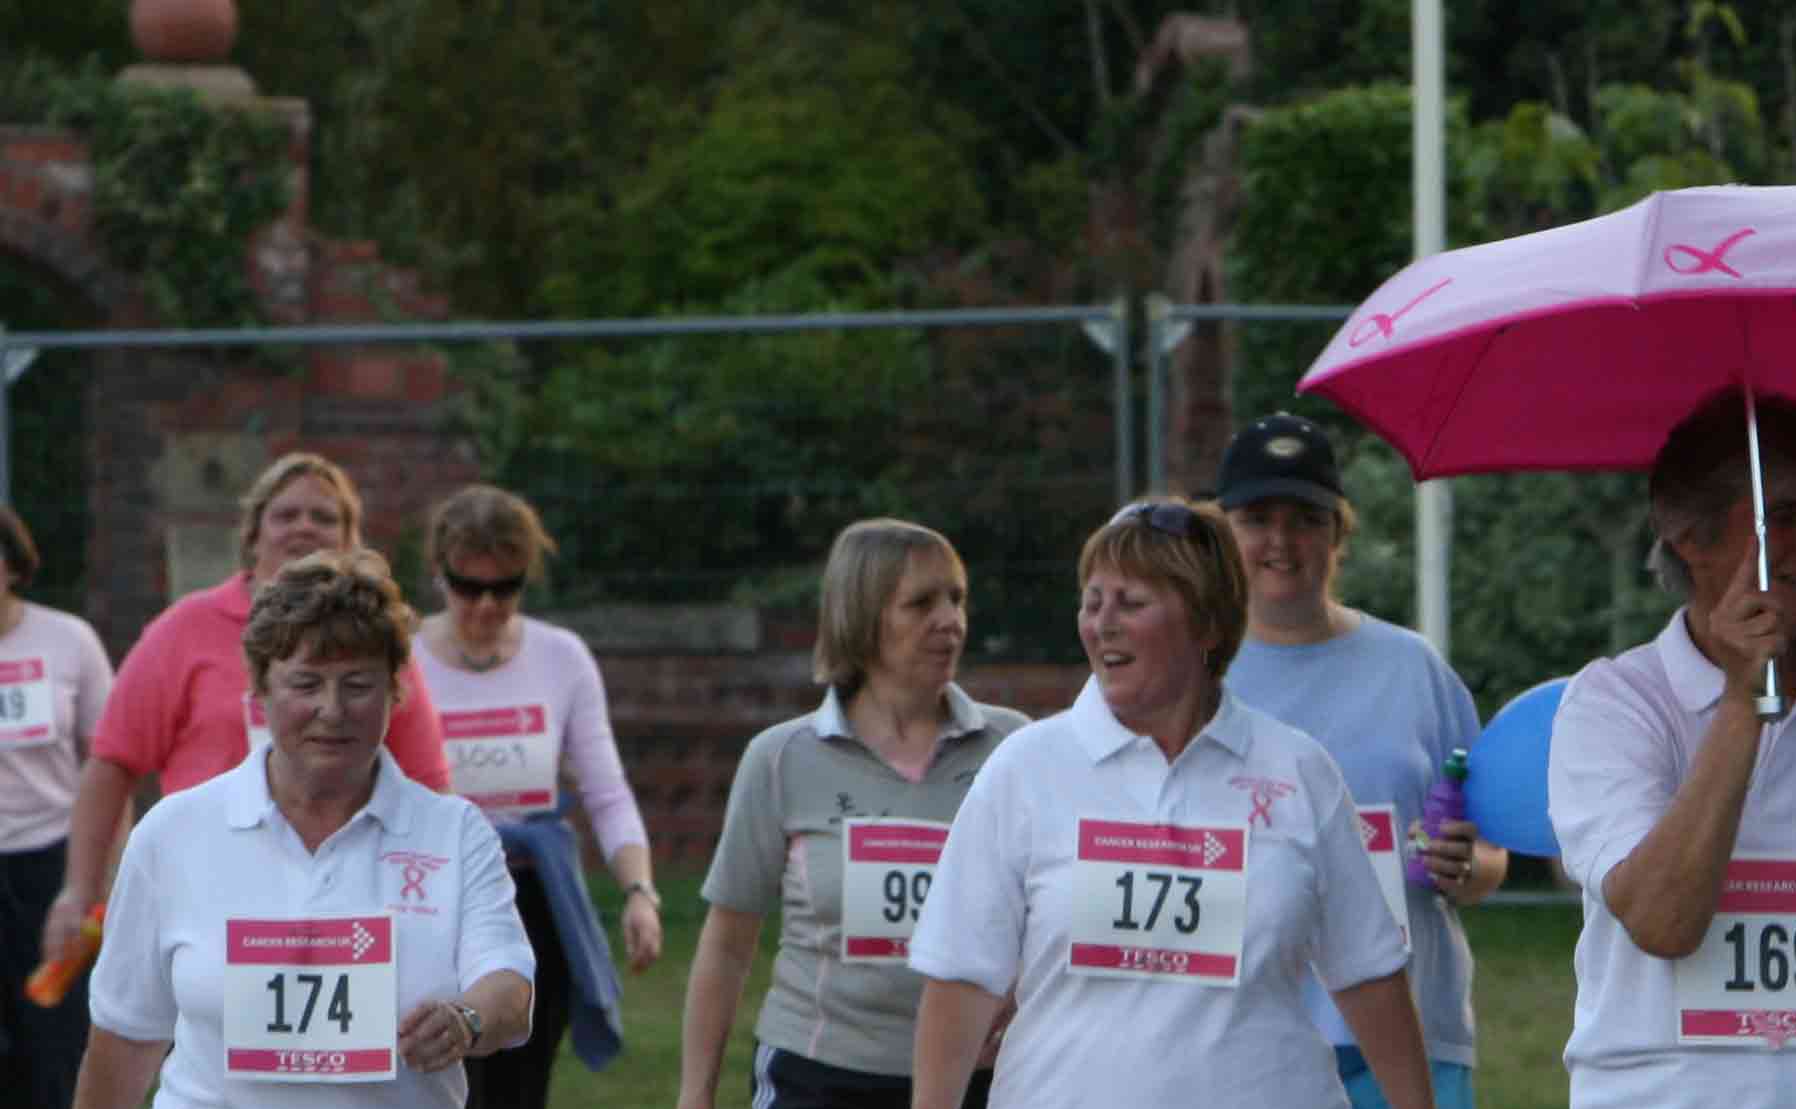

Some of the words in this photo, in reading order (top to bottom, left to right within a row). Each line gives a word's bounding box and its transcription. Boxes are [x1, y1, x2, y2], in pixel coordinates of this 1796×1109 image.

[1113, 870, 1203, 934] 173
[1120, 950, 1189, 969] TESCO
[266, 973, 352, 1034] 174
[277, 1052, 345, 1067] TESCO
